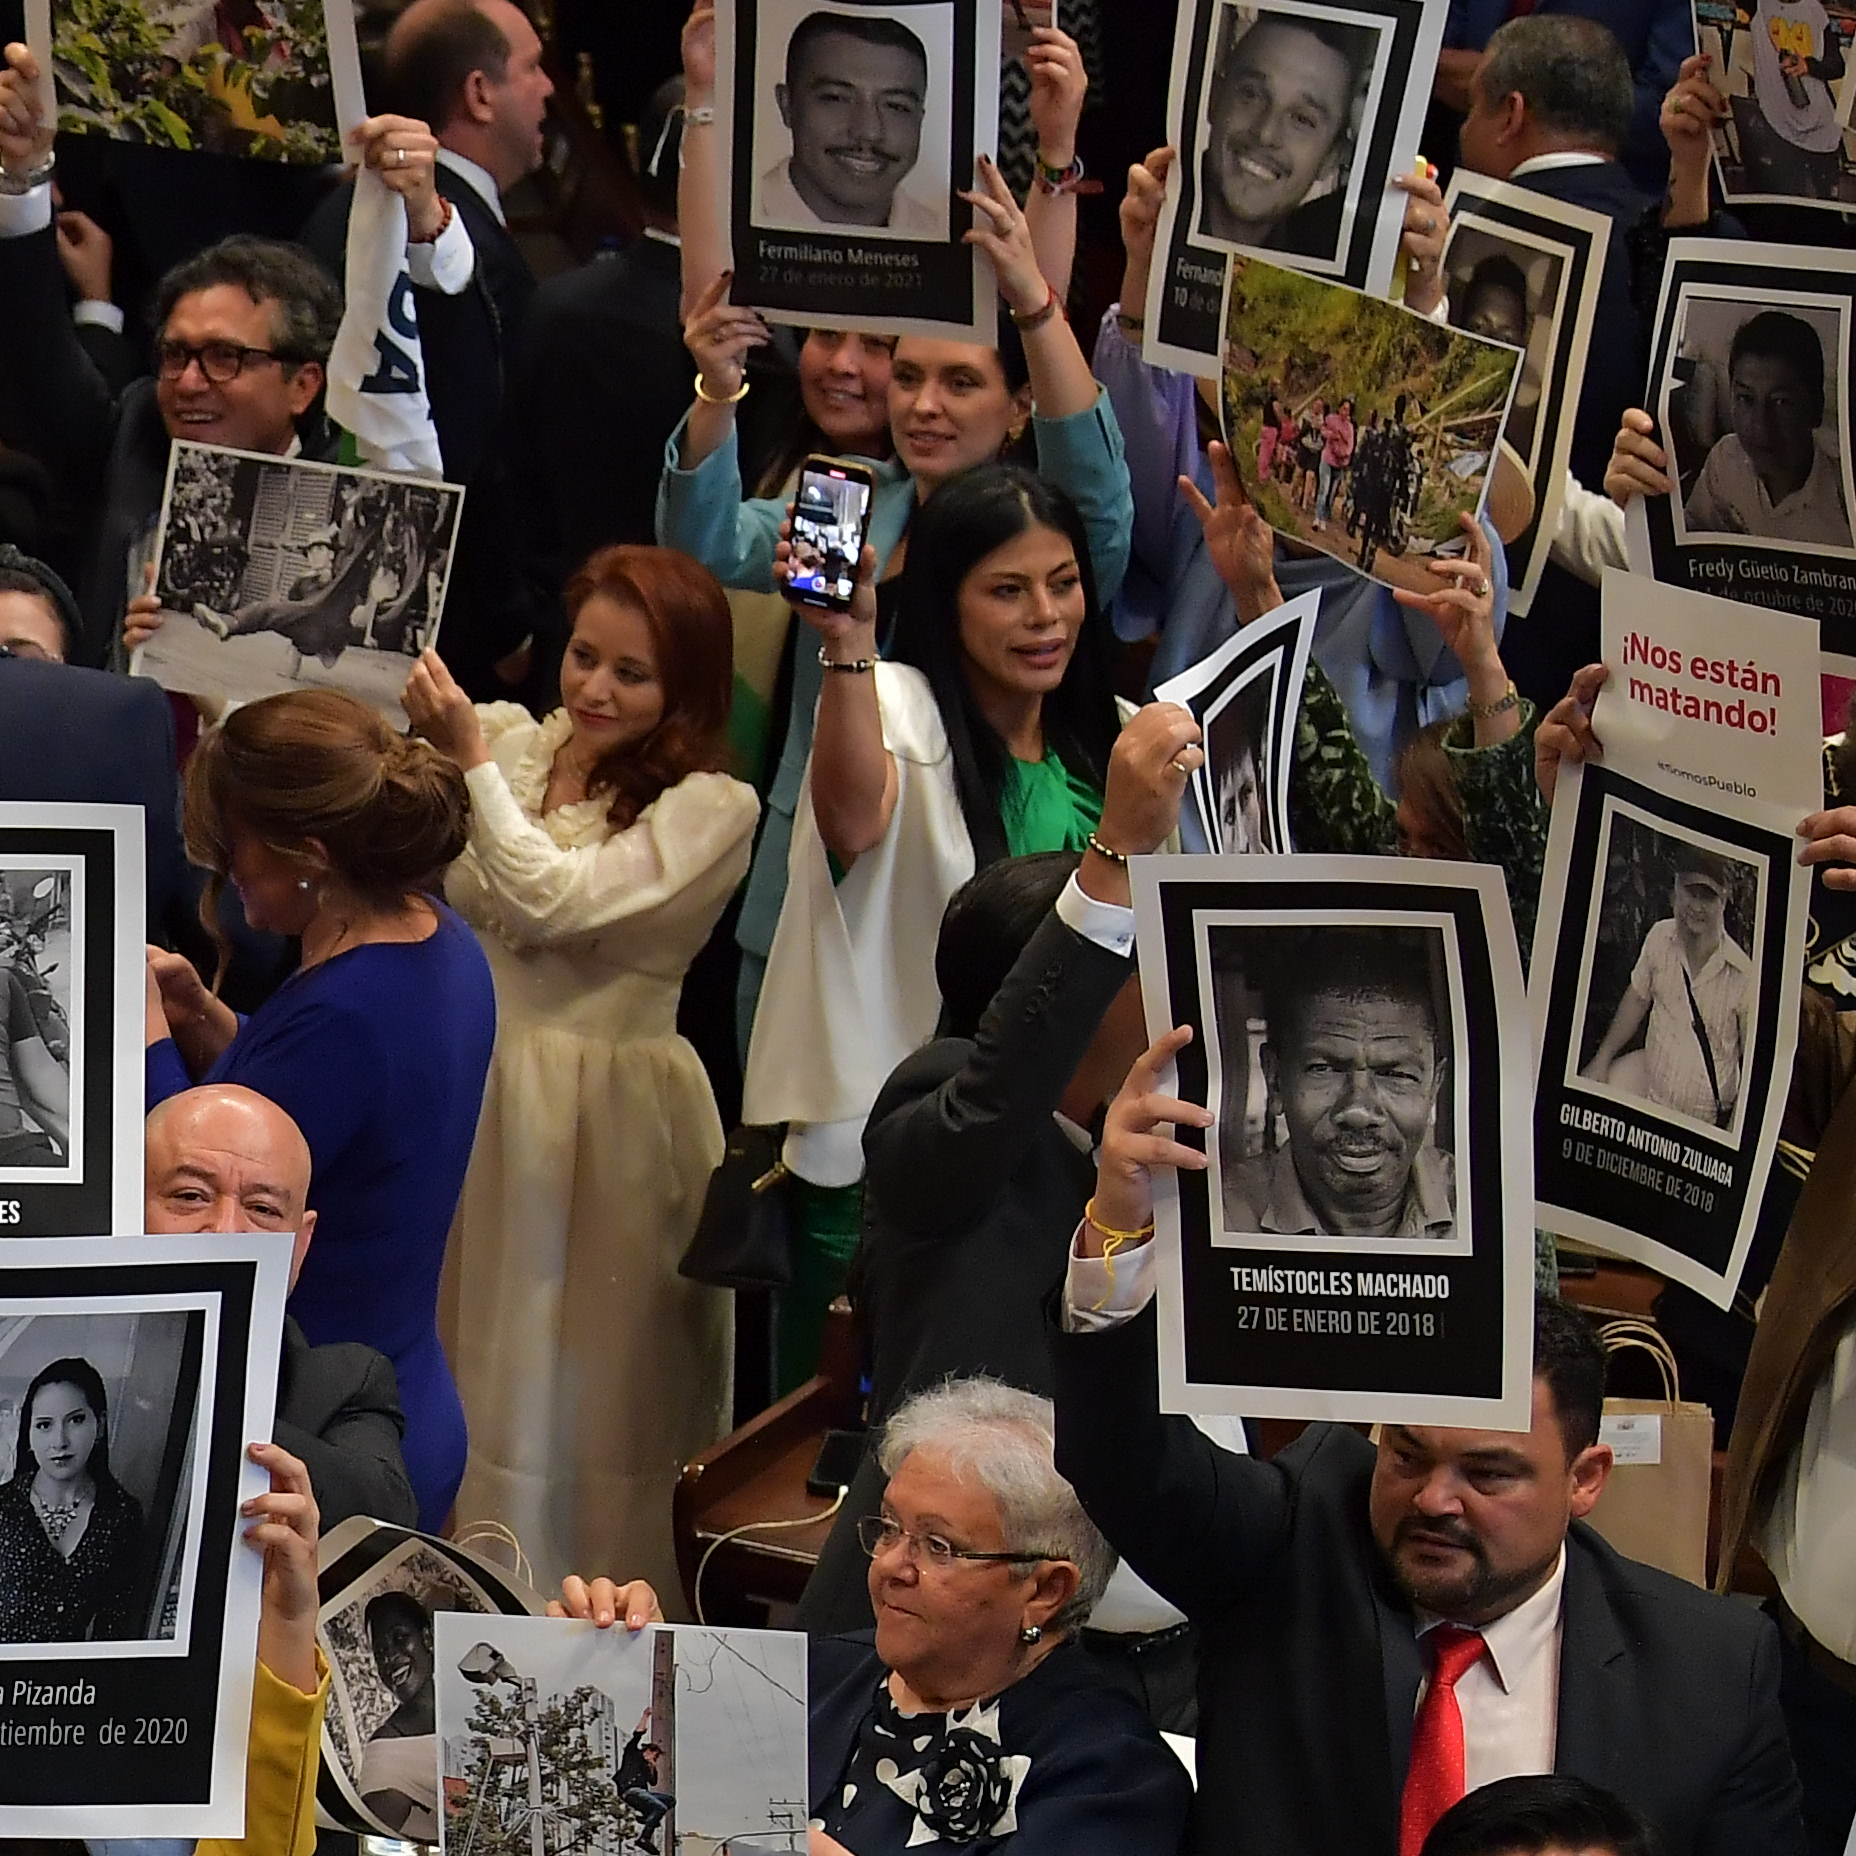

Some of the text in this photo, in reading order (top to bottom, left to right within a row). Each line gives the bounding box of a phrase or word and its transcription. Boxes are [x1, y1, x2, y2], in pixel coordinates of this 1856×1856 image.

[758, 240, 919, 268] Fermiliano Meneses
[1689, 557, 1856, 591] Fredy Güetio Zambran
[1828, 597, 1856, 617] 202
[1622, 631, 1781, 697] ¡Nos están
[1629, 677, 1777, 736] matando!
[1559, 1103, 1734, 1188] GILBERTO ANTONIO ZULUAGA
[1562, 1138, 1715, 1213] 9 DE DICIEMBRE DE 2018
[1230, 1265, 1450, 1299] TEMÍSTOCLES MACHADO
[1238, 1306, 1435, 1337] 27 DE ENERO DE 2018
[12, 1678, 96, 1706] Pizanda
[99, 1717, 126, 1744] de
[134, 1718, 188, 1745] 2020
